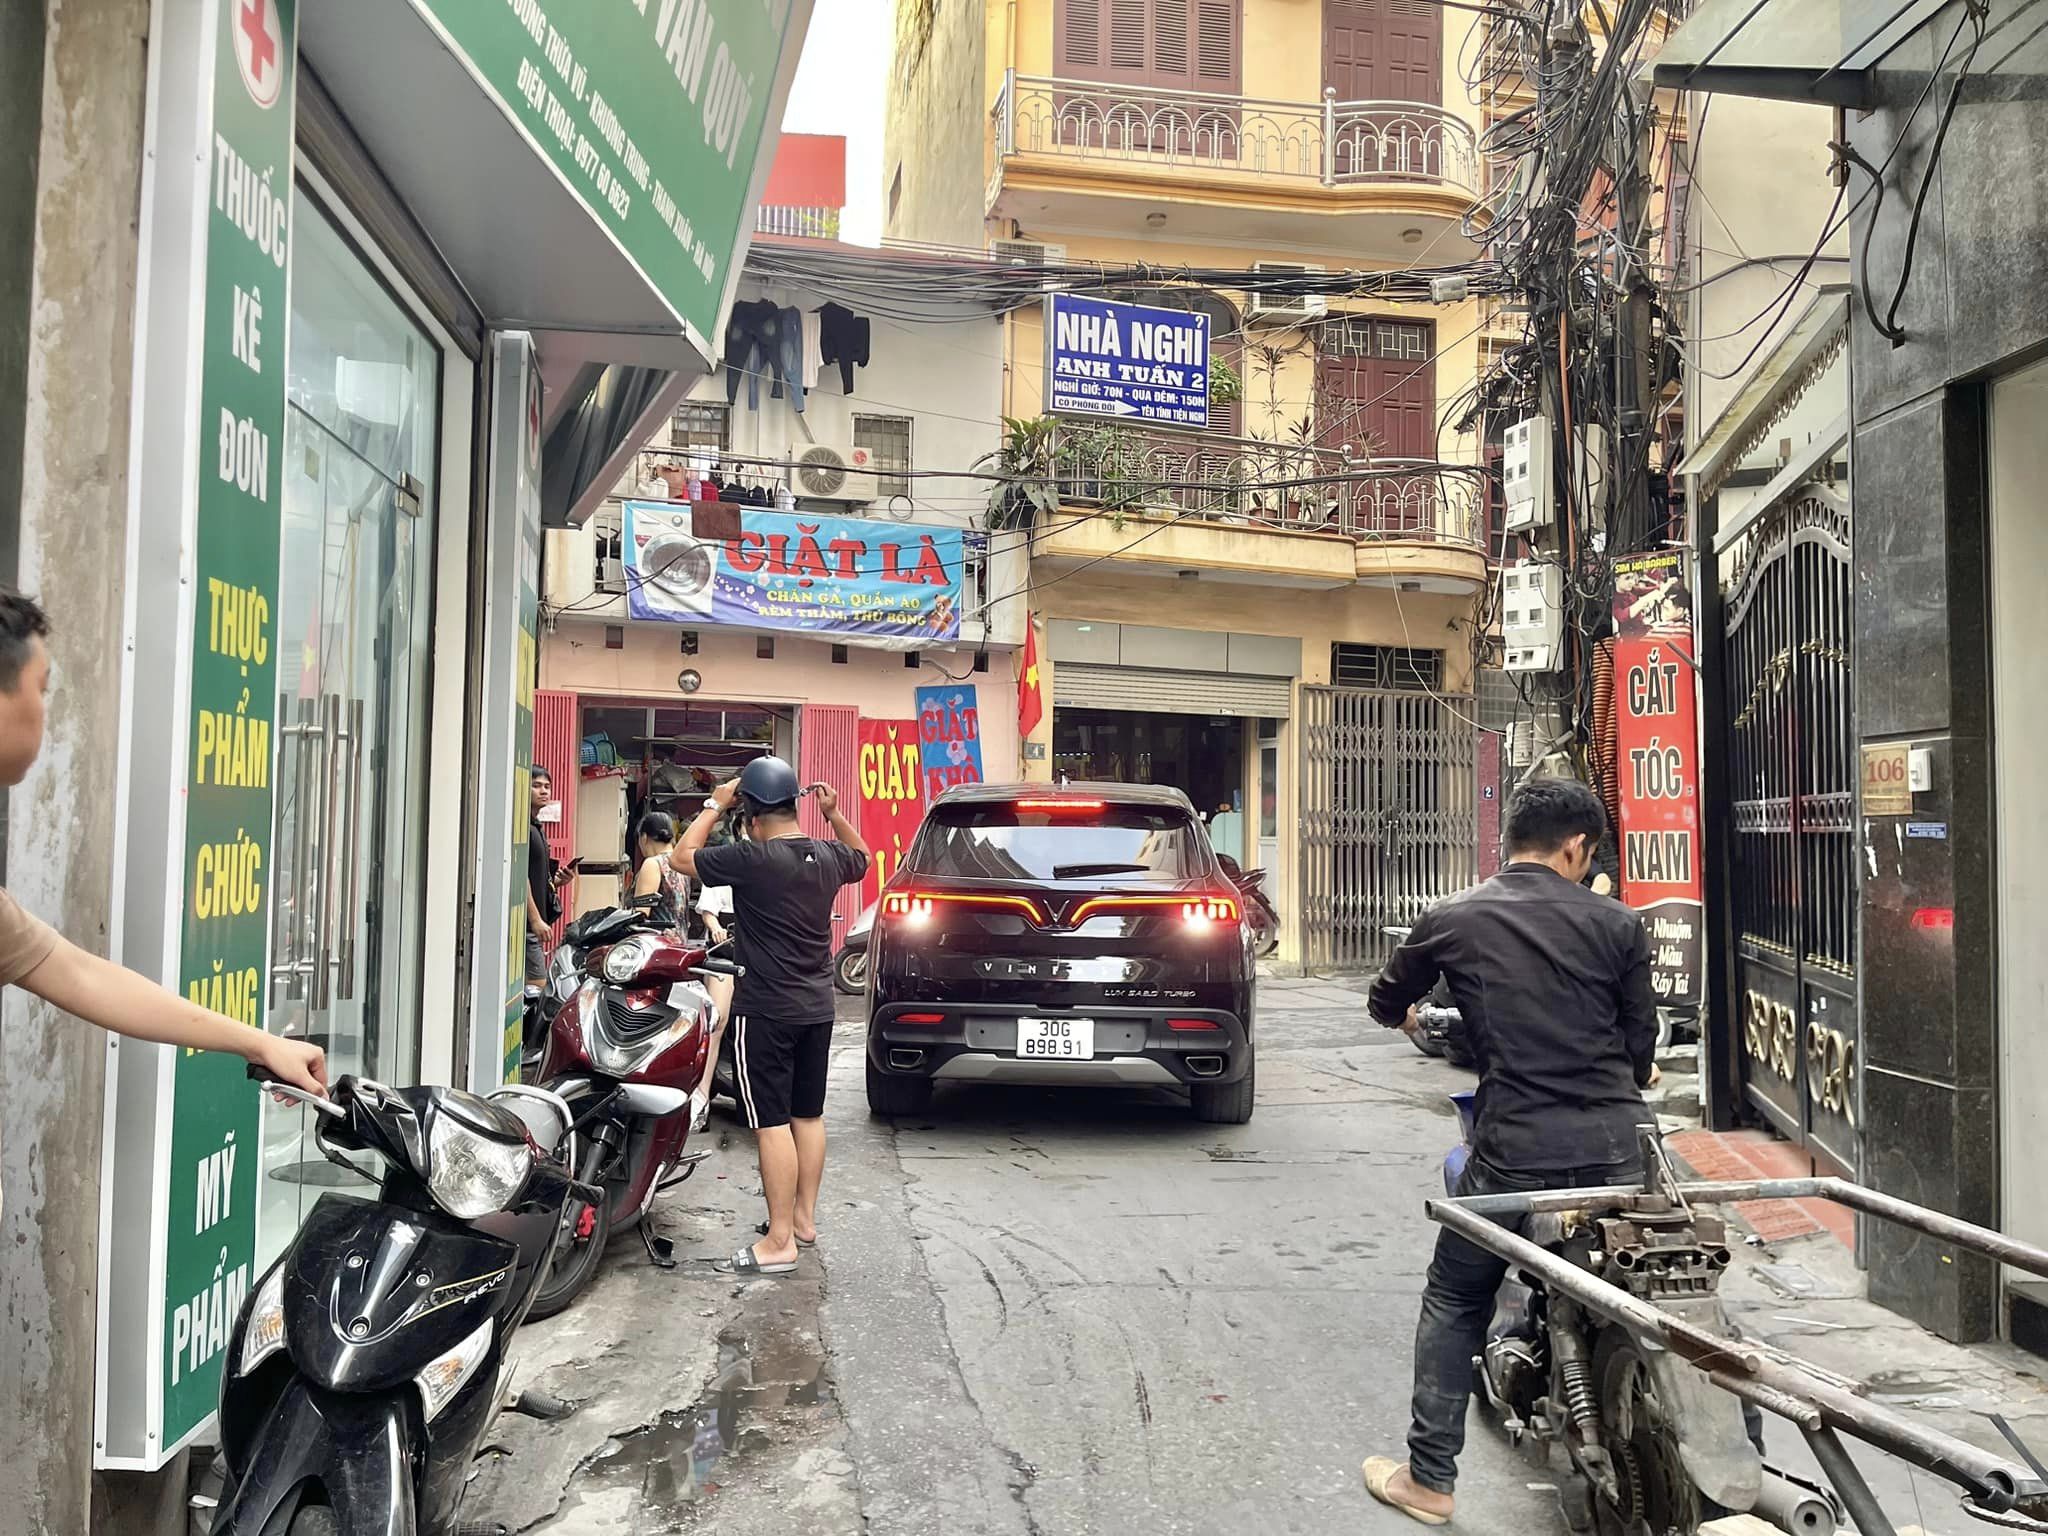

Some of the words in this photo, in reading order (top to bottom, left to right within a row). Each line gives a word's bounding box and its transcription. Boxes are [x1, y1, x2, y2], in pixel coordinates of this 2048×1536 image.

[703, 41, 755, 171] QUÝ
[517, 56, 547, 113] ĐIỆN
[545, 90, 577, 153] THOẠI:
[574, 134, 600, 180] 0977
[597, 163, 611, 196] 60
[608, 178, 631, 221] 6623
[589, 90, 626, 158] KHƯƠNG
[623, 138, 650, 192] TRUNG
[652, 178, 677, 229] THANH
[215, 132, 286, 268] THUỐC
[232, 284, 262, 375] KÊ
[1057, 309, 1122, 357] NHÀ
[1131, 315, 1204, 367] NGHỈ
[1054, 378, 1079, 394] NGHỈ
[1081, 383, 1101, 396] GIỜ:
[1103, 386, 1123, 398] 70N
[1132, 389, 1152, 401] QUA
[1153, 390, 1179, 405] ĐÊM:
[1181, 394, 1206, 407] 150N
[1055, 356, 1111, 379] ANH
[1118, 363, 1184, 387] TUẤN
[1191, 372, 1205, 389] 2
[219, 406, 268, 503] ĐƠN
[724, 522, 867, 588] GIẶT
[880, 535, 951, 588] LÀ
[208, 576, 269, 677] THỰC
[1628, 649, 1679, 718] CẮT
[196, 687, 269, 788] PHẨM
[920, 698, 977, 751] GIẶT
[859, 725, 920, 816] GIẶT
[1485, 786, 1492, 798] 2
[1630, 736, 1682, 799] TÓC
[1867, 757, 1905, 784] 106
[195, 827, 261, 920] CHỨC
[1626, 830, 1691, 884] NAM
[1653, 916, 1692, 944] Nhuộm
[1658, 944, 1684, 967] Màu
[1651, 971, 1673, 998] Ráy
[1674, 972, 1690, 995] Tai
[1026, 1039, 1082, 1056] 898.91
[1039, 1021, 1071, 1037] 30G
[195, 1129, 237, 1236] MỸ
[171, 1246, 249, 1386] PHẨM
[463, 1271, 506, 1305] REVO
